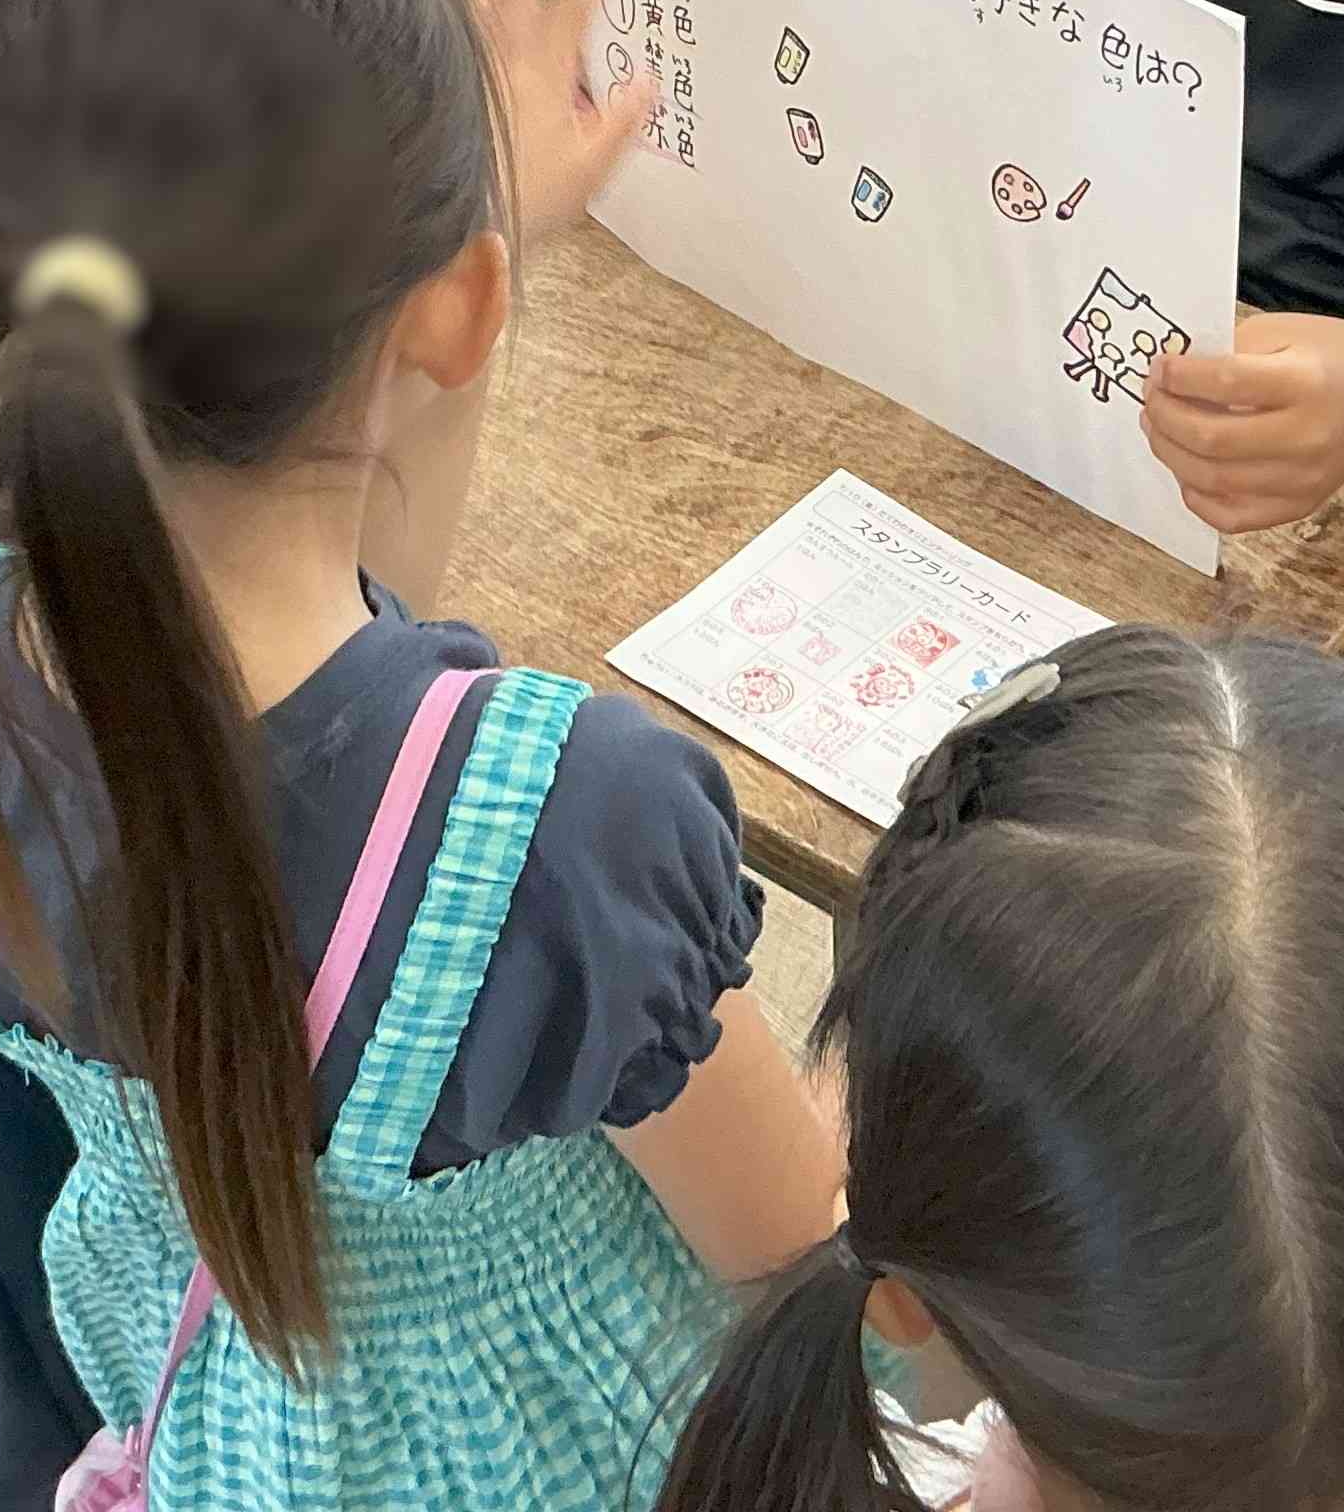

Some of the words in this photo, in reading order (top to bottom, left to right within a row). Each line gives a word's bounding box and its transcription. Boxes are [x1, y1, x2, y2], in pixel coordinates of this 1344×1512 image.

[851, 518, 1032, 626] スタンプラリーカード
